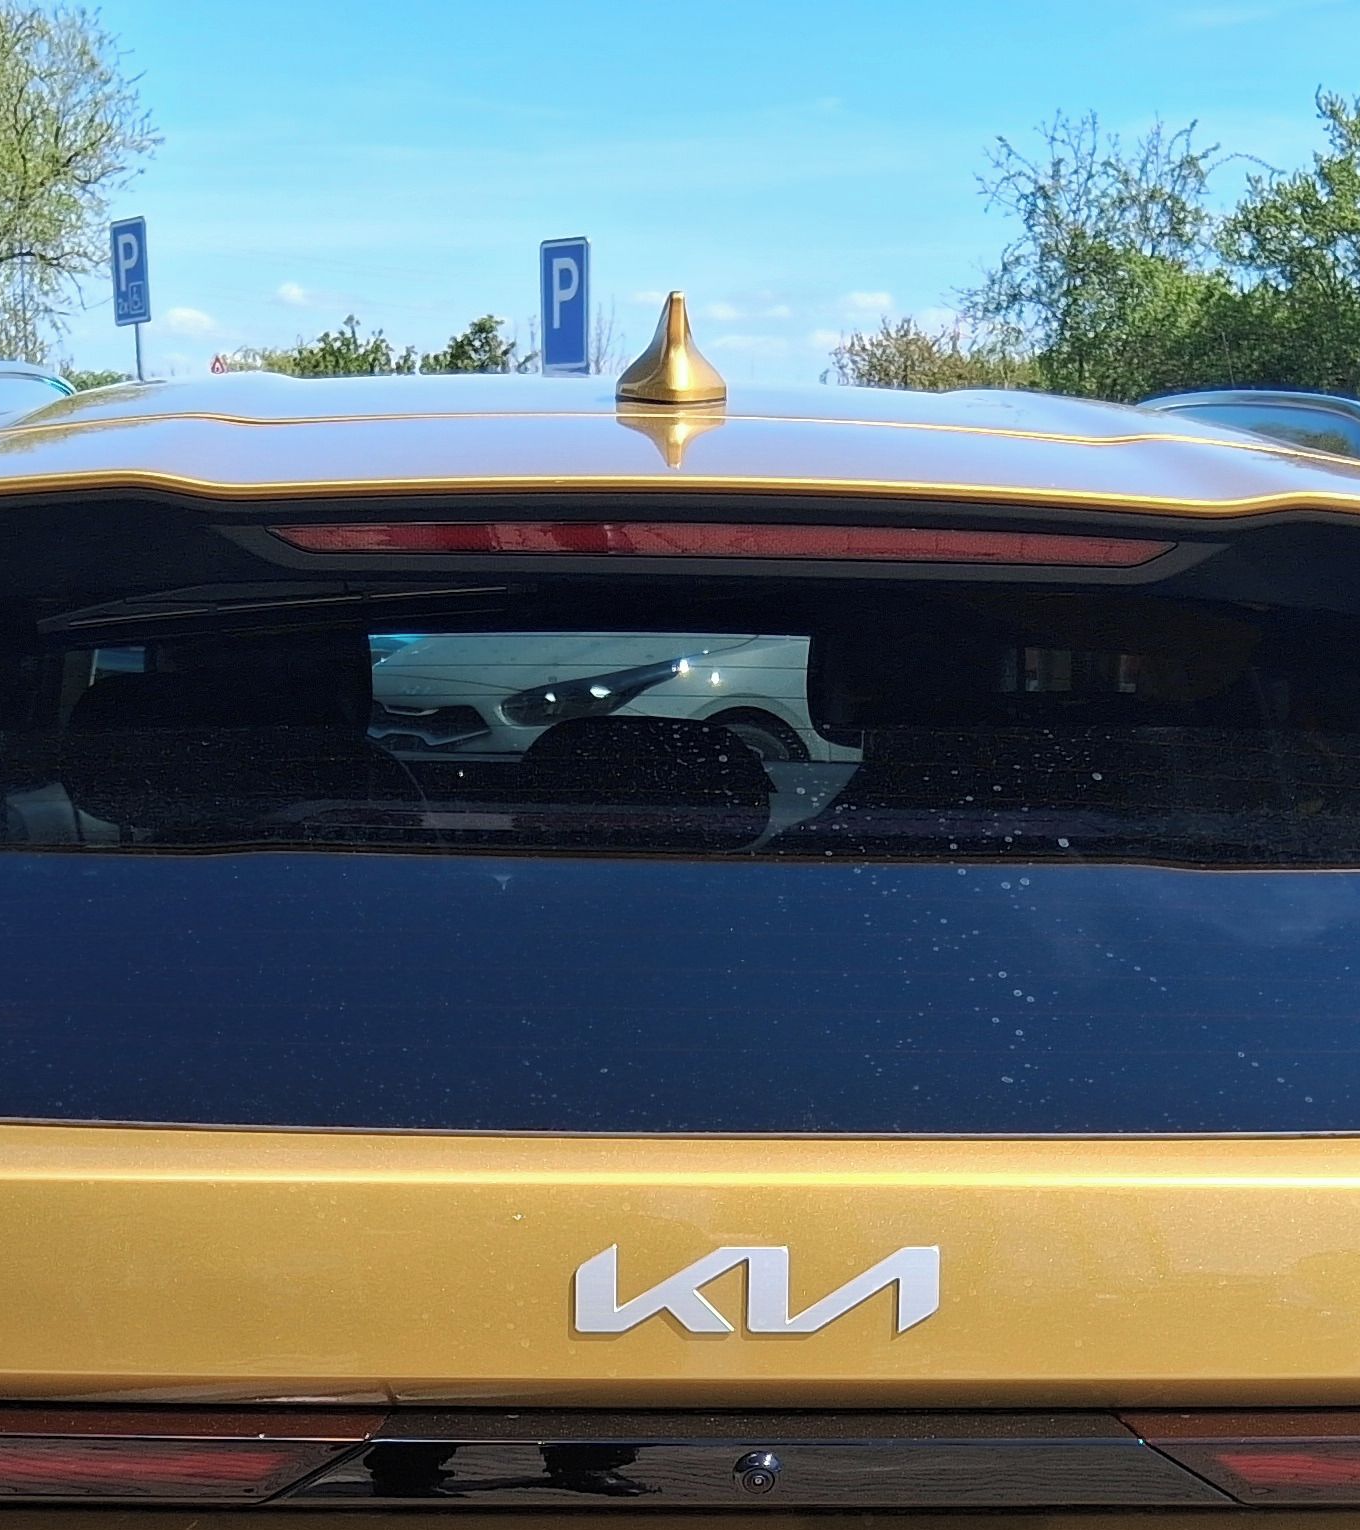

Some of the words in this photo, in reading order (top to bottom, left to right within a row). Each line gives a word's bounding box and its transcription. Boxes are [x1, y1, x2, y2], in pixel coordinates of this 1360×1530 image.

[118, 233, 139, 291] P
[552, 257, 579, 329] P
[575, 1244, 940, 1333] KIA
